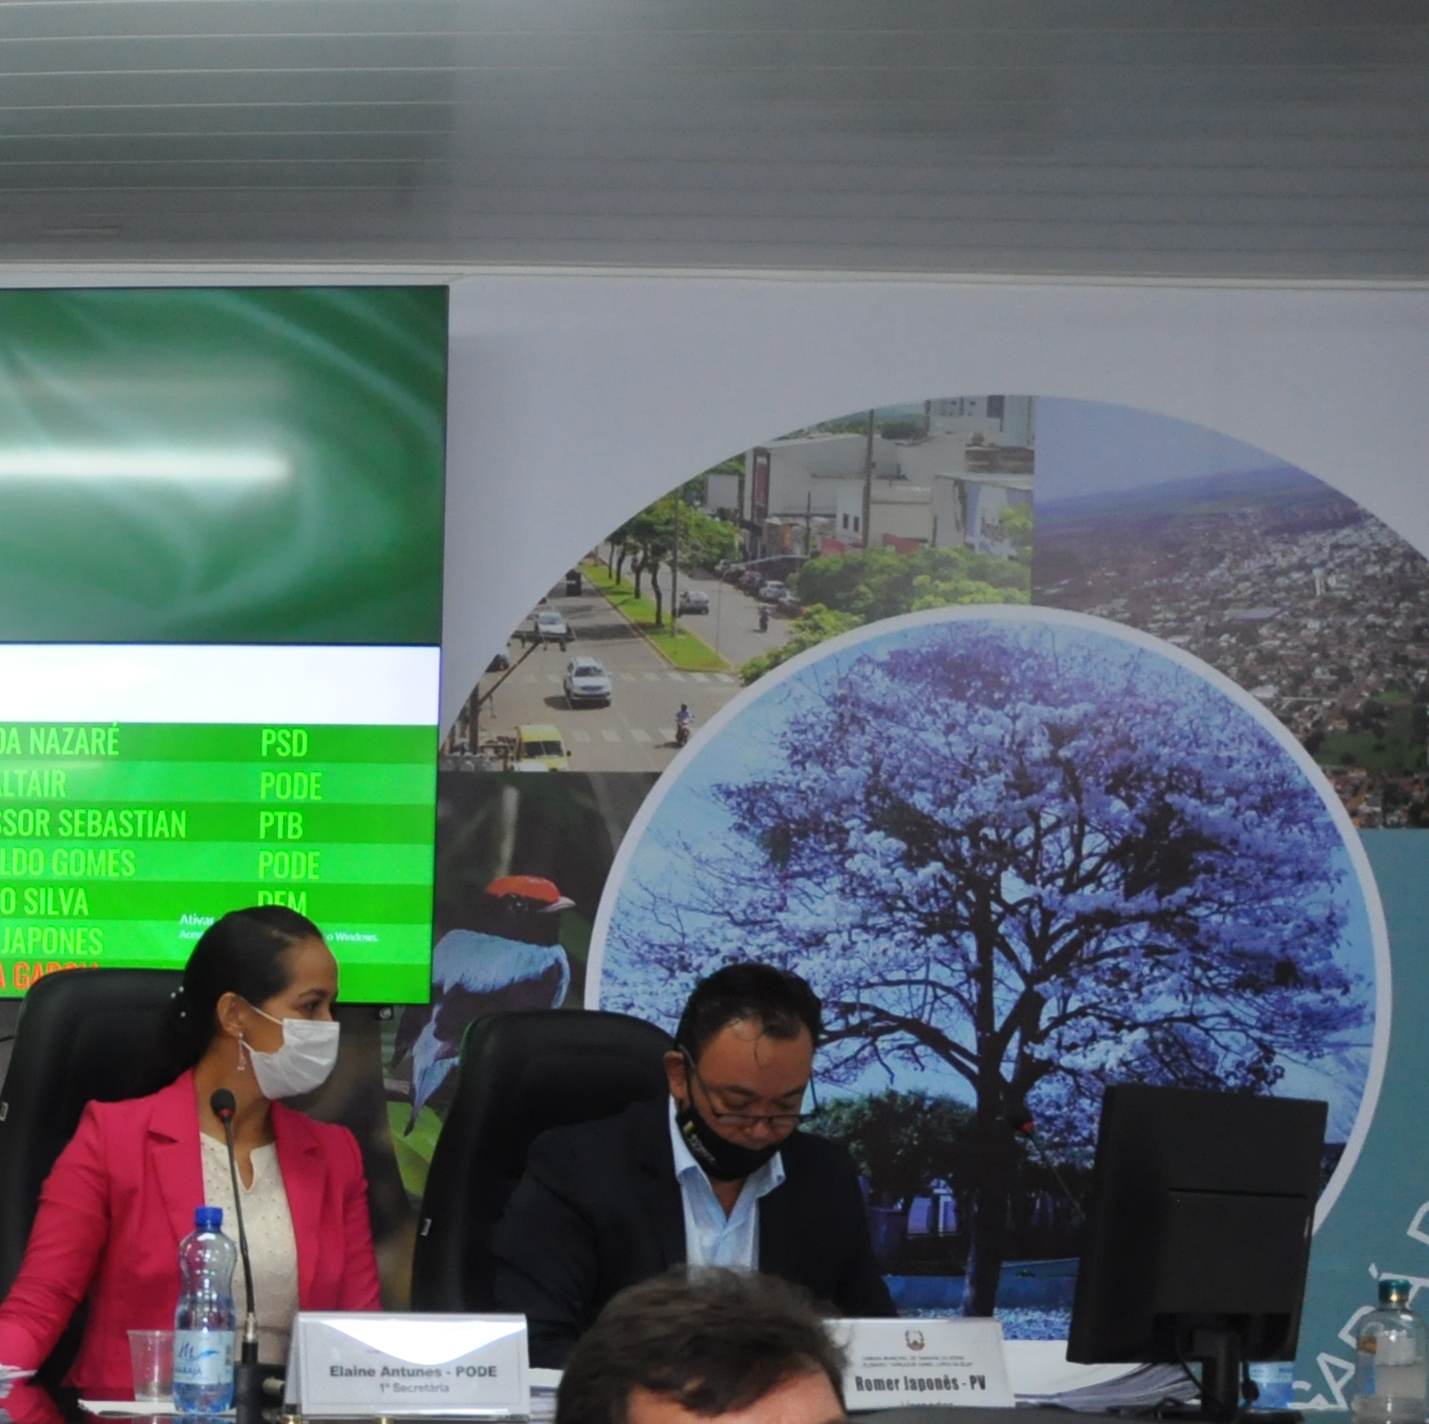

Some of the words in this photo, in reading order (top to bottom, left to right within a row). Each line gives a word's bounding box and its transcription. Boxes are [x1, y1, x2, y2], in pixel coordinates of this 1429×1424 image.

[28, 722, 120, 756] NAZARÉ
[261, 728, 309, 757] PSD
[260, 772, 323, 800] PODE
[58, 809, 187, 839] SEBASTIAN
[259, 811, 303, 840] PTB
[52, 848, 136, 877] GOMES
[258, 851, 321, 880] PODE
[23, 887, 89, 917] SILVA
[0, 926, 105, 956] JAPONES
[330, 1364, 376, 1378] Elaine
[380, 1365, 443, 1378] Antunes
[455, 1365, 498, 1378] PODE
[855, 1375, 900, 1392] Romer
[969, 1374, 987, 1391] PV
